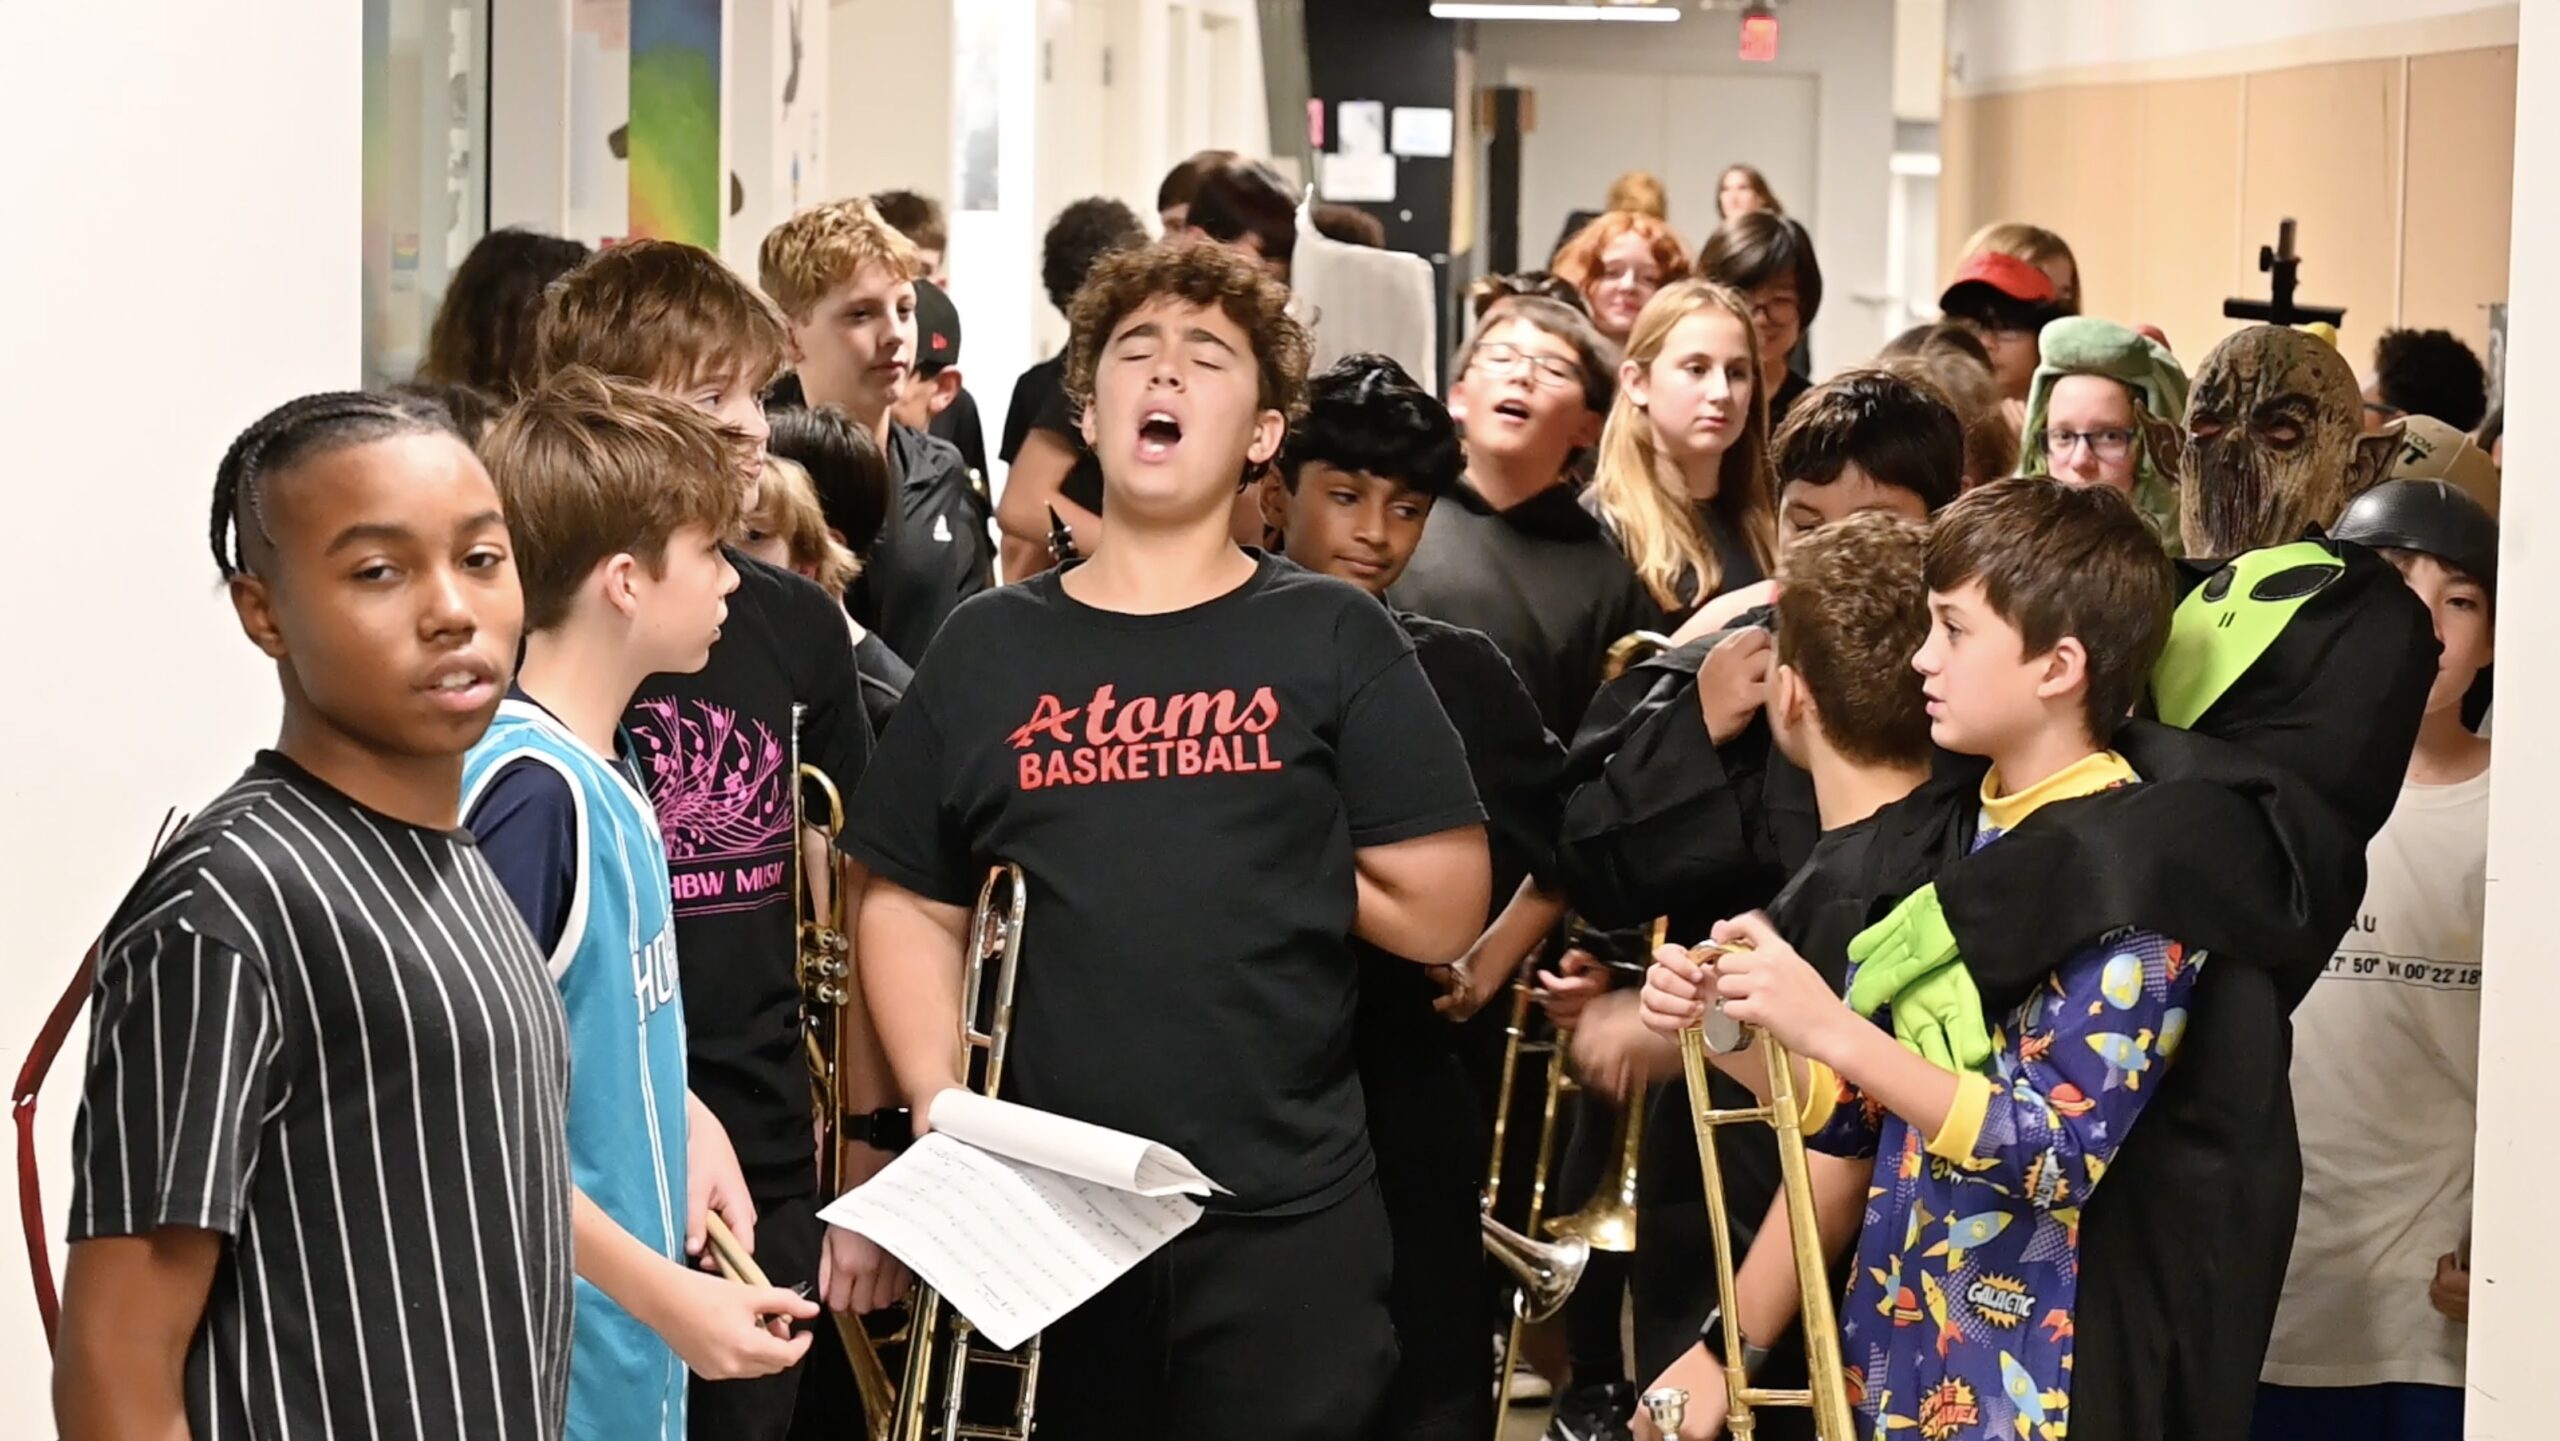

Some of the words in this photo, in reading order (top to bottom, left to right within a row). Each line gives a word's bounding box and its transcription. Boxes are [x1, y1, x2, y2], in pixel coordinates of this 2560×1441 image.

[1004, 684, 1280, 750] Atoms
[1019, 733, 1282, 790] BASKETBALL
[1967, 1282, 2036, 1317] GALACTIC
